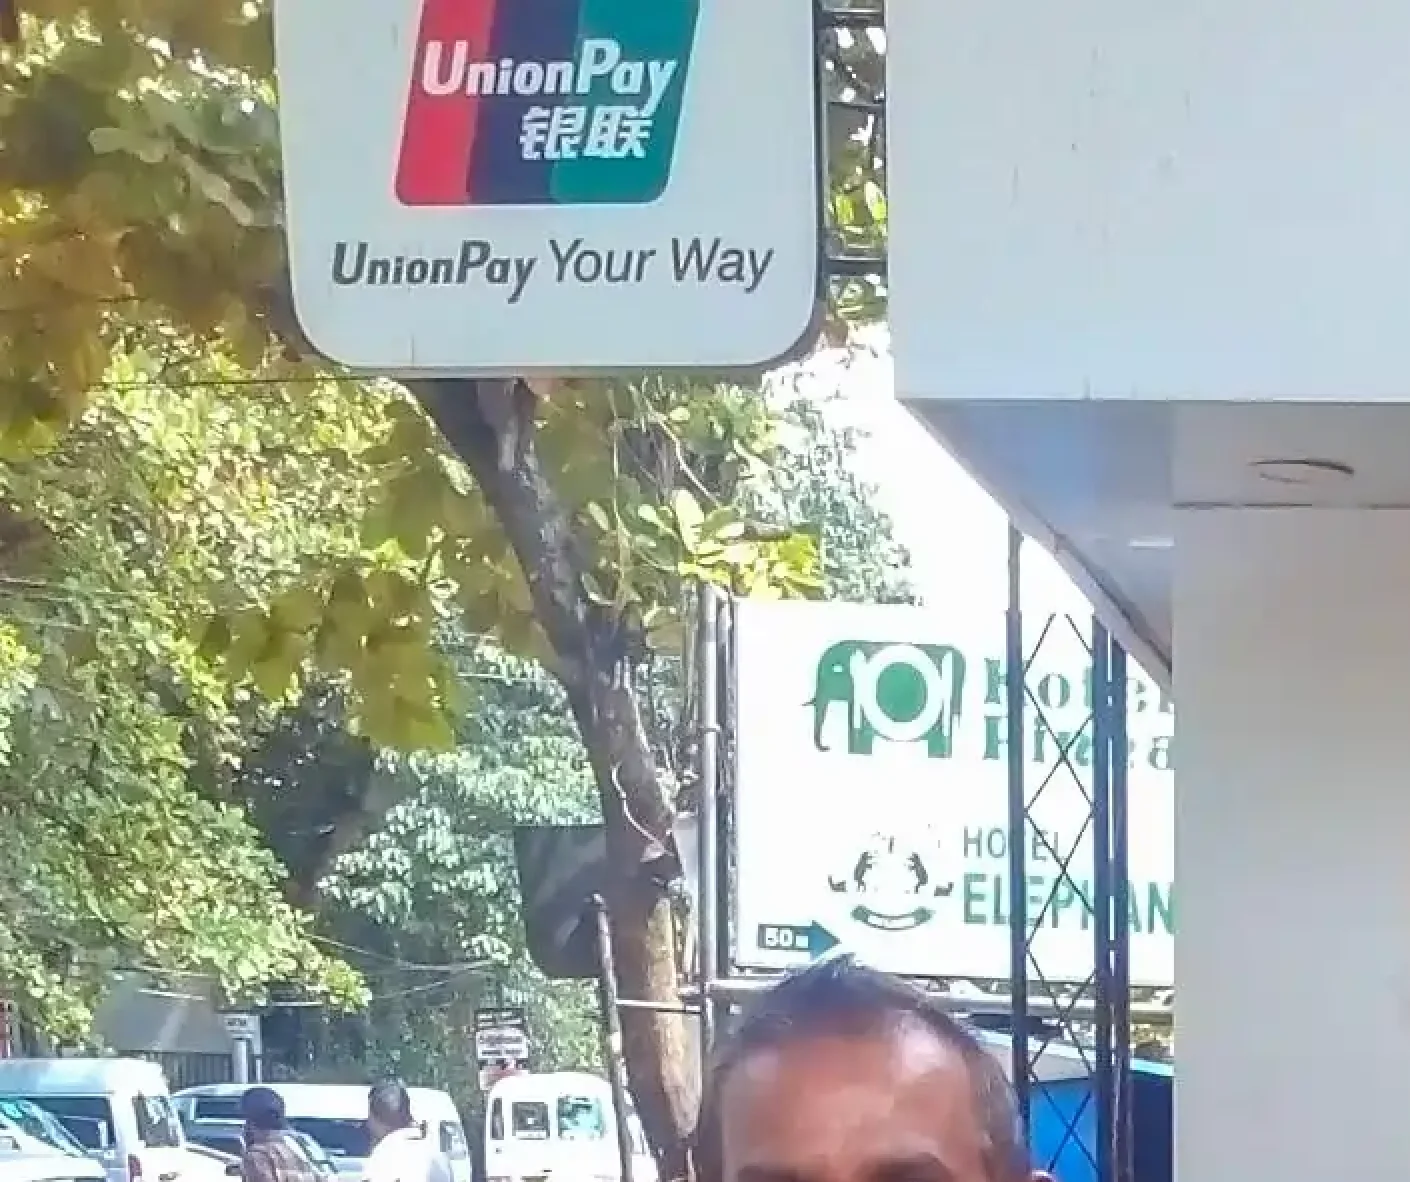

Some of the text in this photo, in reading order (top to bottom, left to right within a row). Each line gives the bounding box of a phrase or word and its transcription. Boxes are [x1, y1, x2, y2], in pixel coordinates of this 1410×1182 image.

[422, 38, 678, 117] UnionPay
[519, 105, 653, 160] 银联
[332, 237, 774, 304] UnionPay Your Way
[963, 825, 1065, 862] HOEL
